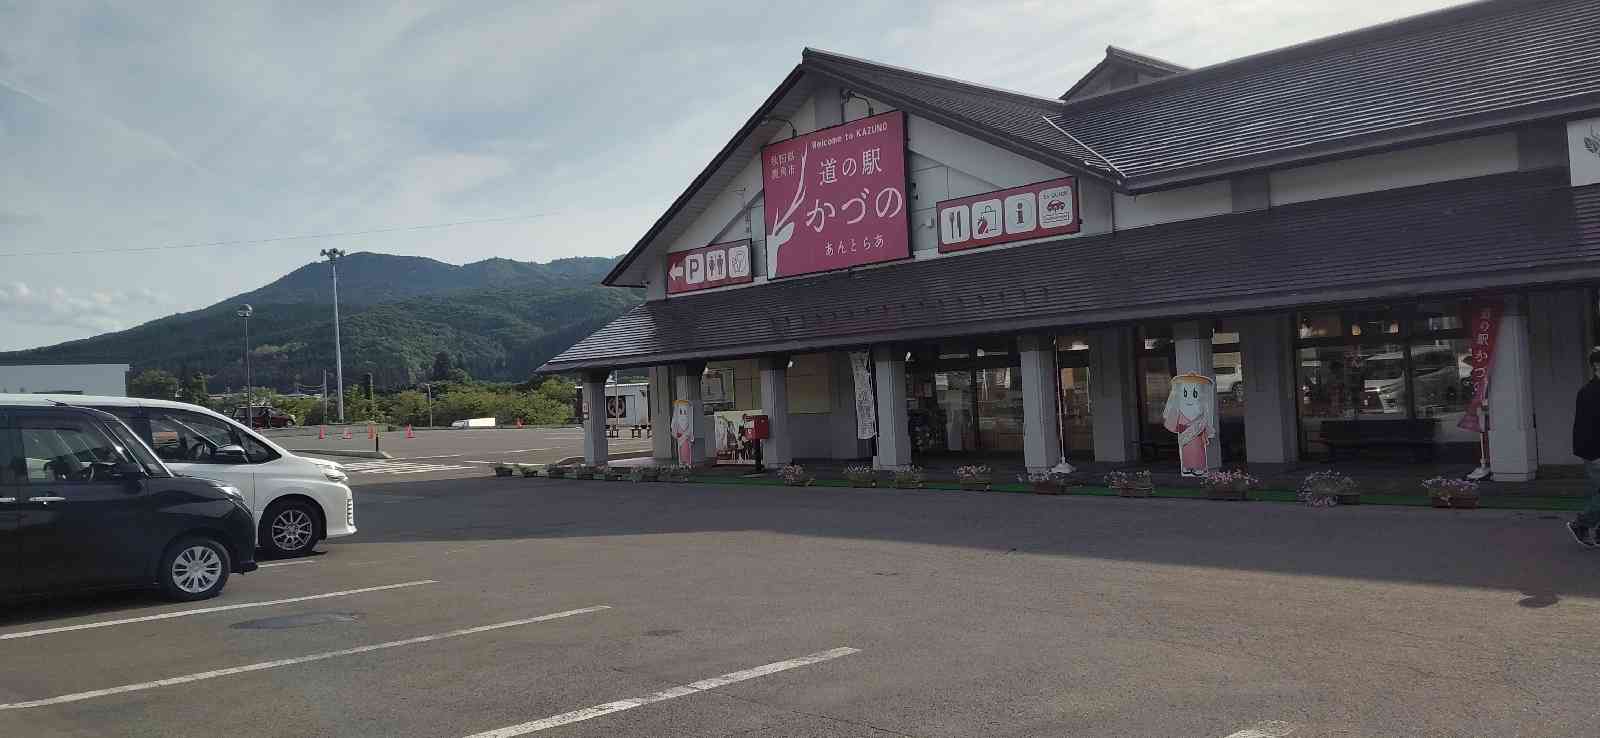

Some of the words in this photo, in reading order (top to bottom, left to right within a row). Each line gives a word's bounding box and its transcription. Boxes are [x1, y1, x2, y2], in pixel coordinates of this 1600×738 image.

[812, 135, 842, 150] Welcome
[845, 133, 854, 141] to
[856, 121, 888, 137] KAZUNO
[818, 147, 883, 186] 道の駅
[806, 187, 903, 233] かづの
[825, 234, 884, 256] あんとらあ
[689, 258, 699, 281] P
